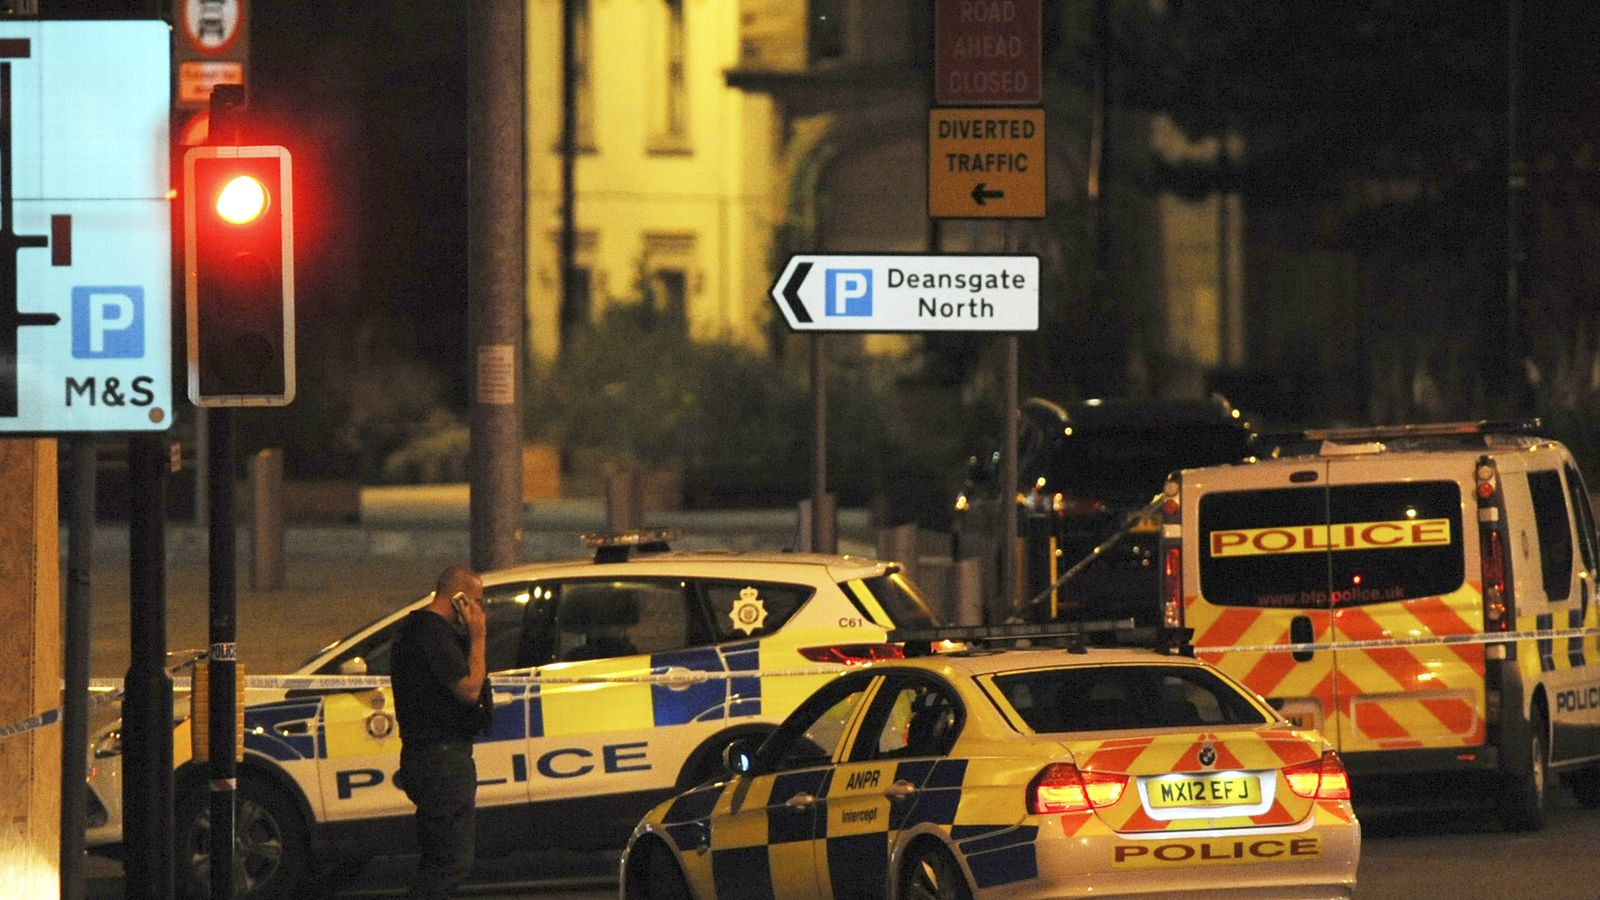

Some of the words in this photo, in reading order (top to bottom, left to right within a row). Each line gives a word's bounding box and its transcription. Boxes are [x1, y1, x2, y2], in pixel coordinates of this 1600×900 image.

[960, 1, 1016, 22] ROAD
[953, 36, 1023, 58] AHEAD
[950, 72, 1028, 93] CLOSED
[938, 120, 1036, 139] DIVERTED
[946, 153, 1028, 172] TRAFFIC
[887, 268, 1025, 292] Deansgate
[835, 272, 868, 314] P
[918, 297, 995, 317] North
[89, 293, 135, 352] P
[65, 376, 155, 407] M&S
[1212, 519, 1448, 555] POLICE
[838, 617, 863, 629] C61
[1556, 686, 1600, 714] POLIC
[336, 741, 652, 799] PICE
[846, 770, 880, 791] ANPR
[1161, 780, 1206, 802] MX12
[841, 807, 878, 823] Intercept
[1114, 838, 1320, 863] POLICE
